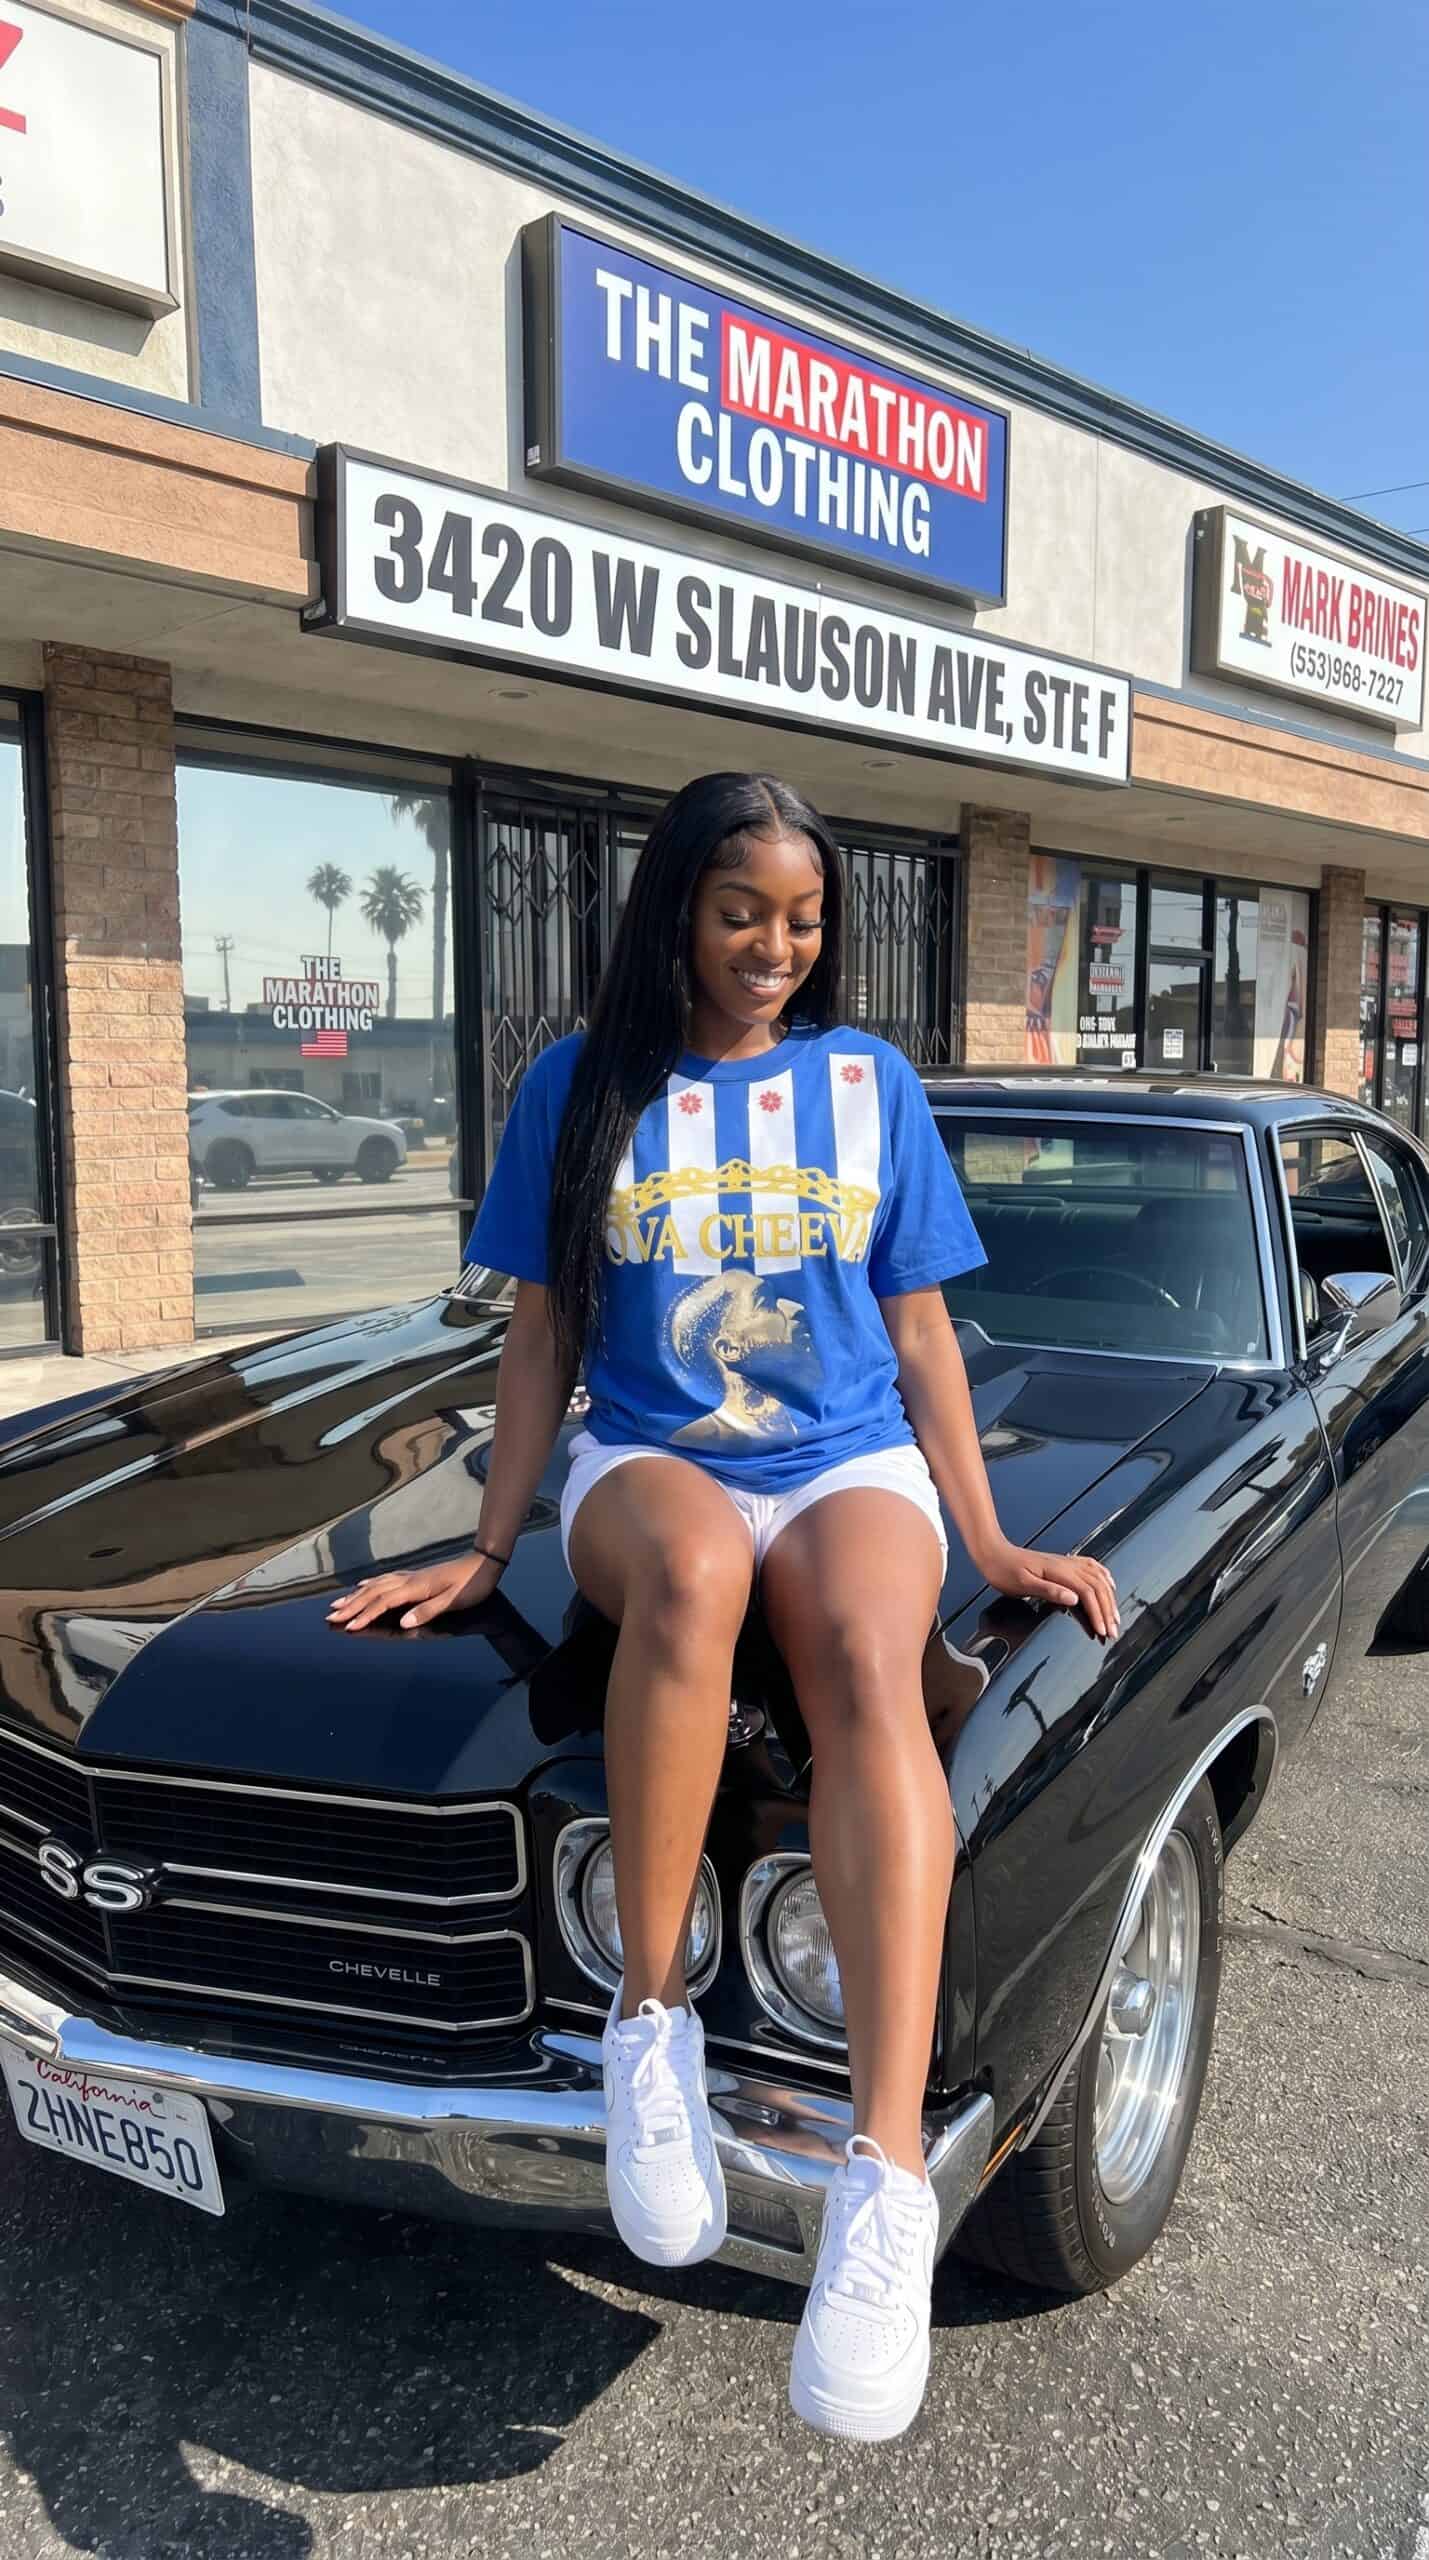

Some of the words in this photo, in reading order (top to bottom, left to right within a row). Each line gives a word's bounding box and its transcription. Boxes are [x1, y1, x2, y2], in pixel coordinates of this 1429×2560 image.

[596, 268, 710, 393] THE
[728, 326, 983, 493] MARATHON
[677, 401, 931, 558] CLOTHING
[374, 493, 573, 638] 3420
[592, 550, 660, 658] W
[676, 575, 917, 716] SLAUSON
[926, 645, 1014, 744] AVE,
[1023, 670, 1089, 755] STE
[1099, 690, 1116, 760] F
[1281, 555, 1344, 644] MARK
[1347, 583, 1420, 672] BRINES
[1290, 641, 1403, 705] (553)968-7227
[264, 978, 378, 1007] MARATHON
[302, 957, 341, 980] THE
[272, 1005, 372, 1031] CLOTHING
[39, 1844, 144, 1911] SS
[329, 1960, 441, 1986] CHEVELLE
[36, 2059, 166, 2119] California
[17, 2079, 203, 2191] 2HNE850
